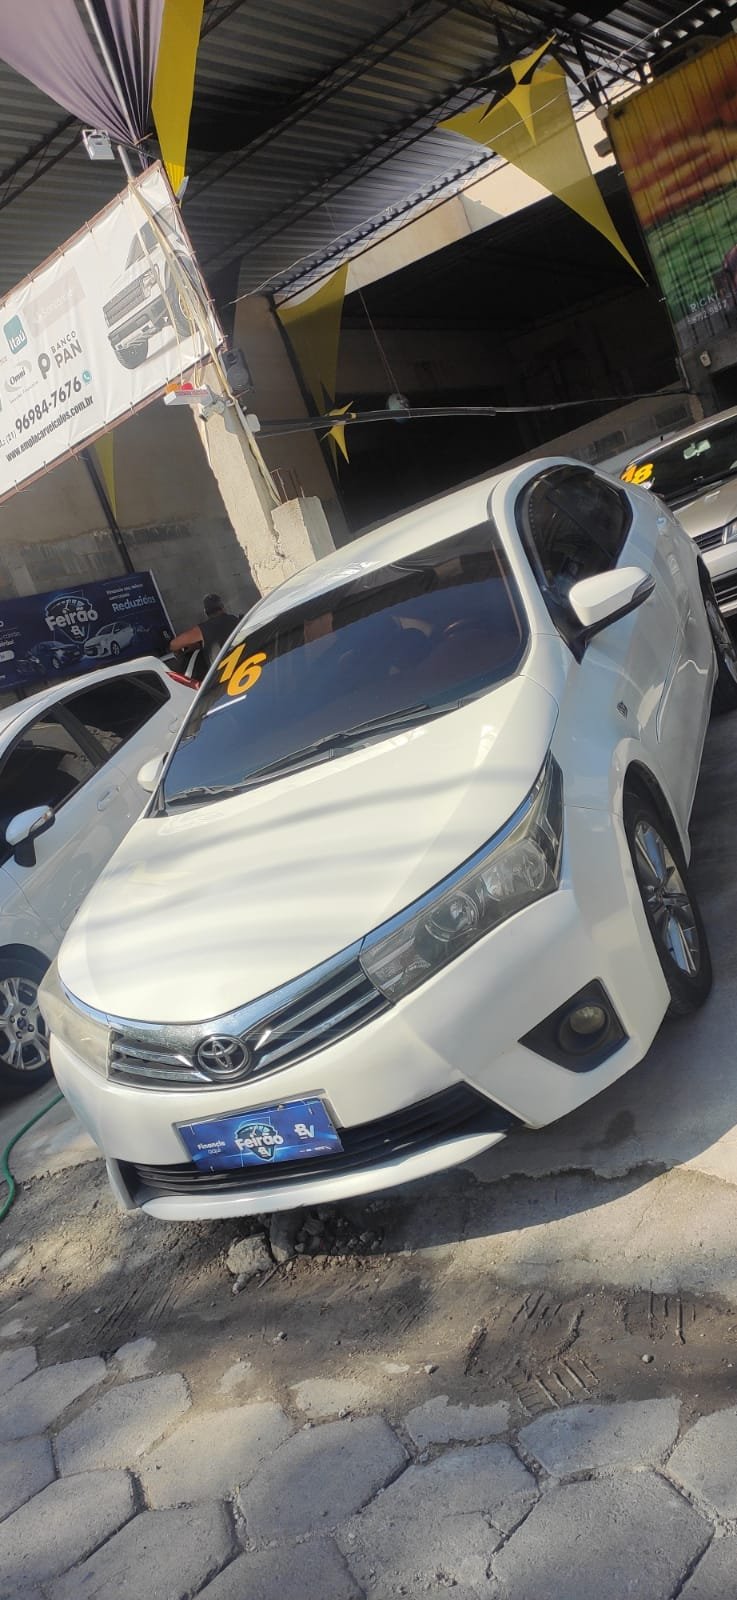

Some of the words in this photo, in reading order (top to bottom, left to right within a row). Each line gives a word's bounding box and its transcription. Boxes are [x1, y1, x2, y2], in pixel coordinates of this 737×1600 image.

[50, 330, 77, 354] BANCO
[54, 339, 83, 368] PAN
[15, 376, 82, 433] 96984-7676
[621, 463, 654, 485] 18
[45, 606, 98, 631] Feirão
[216, 642, 267, 696] 16
[197, 1139, 226, 1150] Financie
[234, 1132, 284, 1151] Feirão
